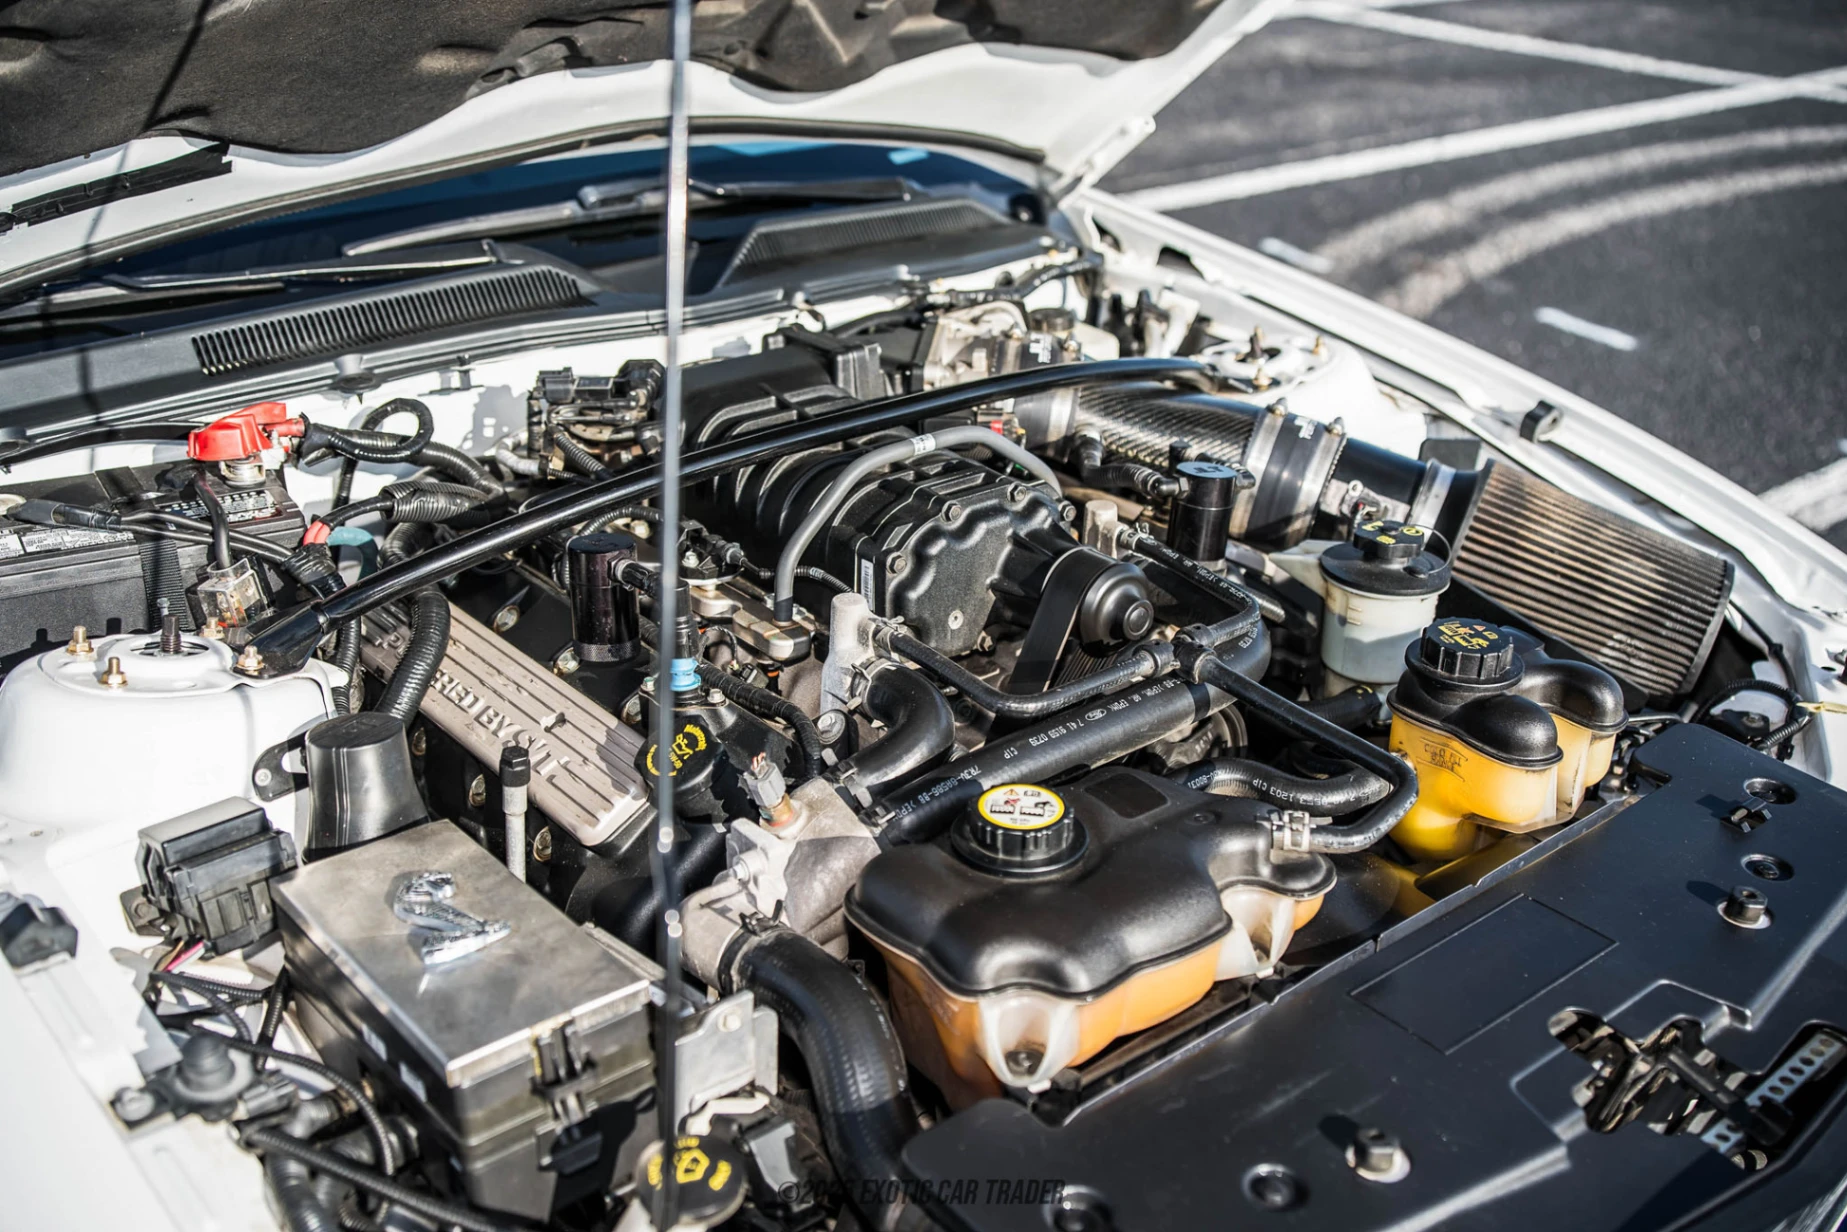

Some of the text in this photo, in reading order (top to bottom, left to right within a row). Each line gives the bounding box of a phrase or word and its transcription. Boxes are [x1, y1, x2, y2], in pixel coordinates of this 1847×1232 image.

[475, 705, 523, 738] BY
[1028, 734, 1048, 747] 0739
[1269, 787, 1294, 803] 1203
